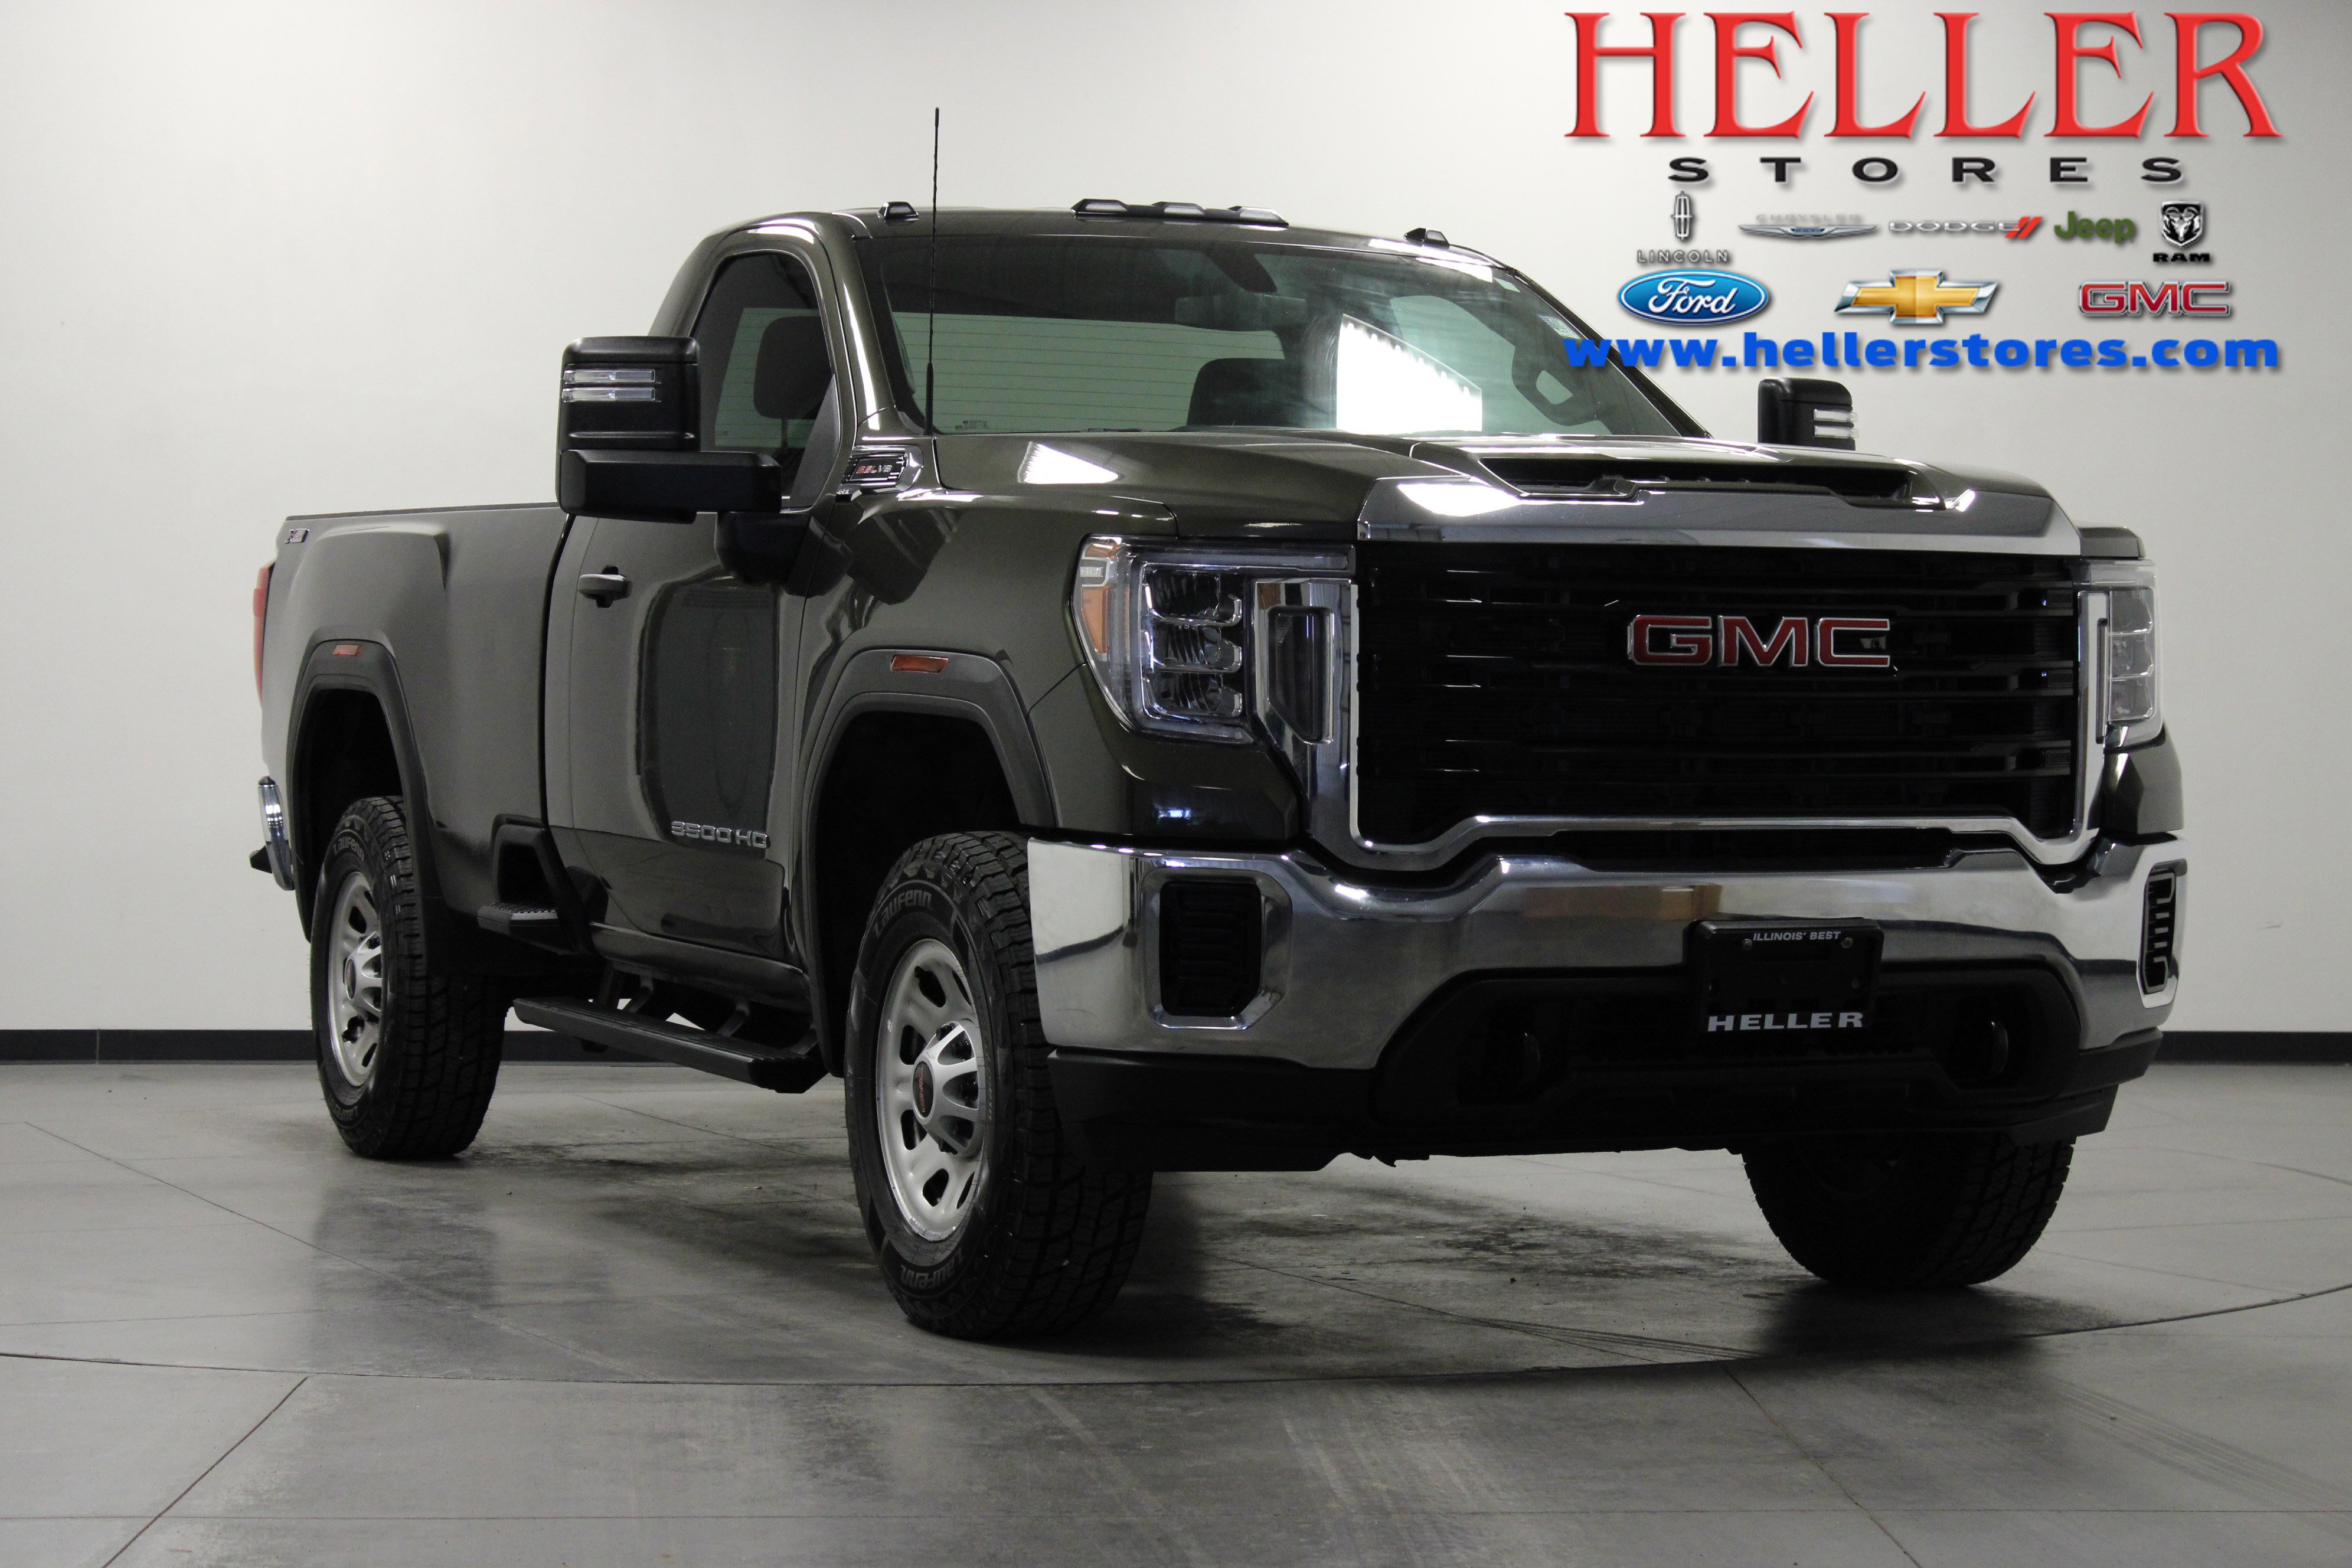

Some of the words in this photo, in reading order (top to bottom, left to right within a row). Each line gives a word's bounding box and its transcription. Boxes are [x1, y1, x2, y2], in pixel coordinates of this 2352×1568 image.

[1628, 615, 1890, 668] GMC
[1809, 931, 1841, 940] BEST
[1707, 1012, 1863, 1031] HELLER
